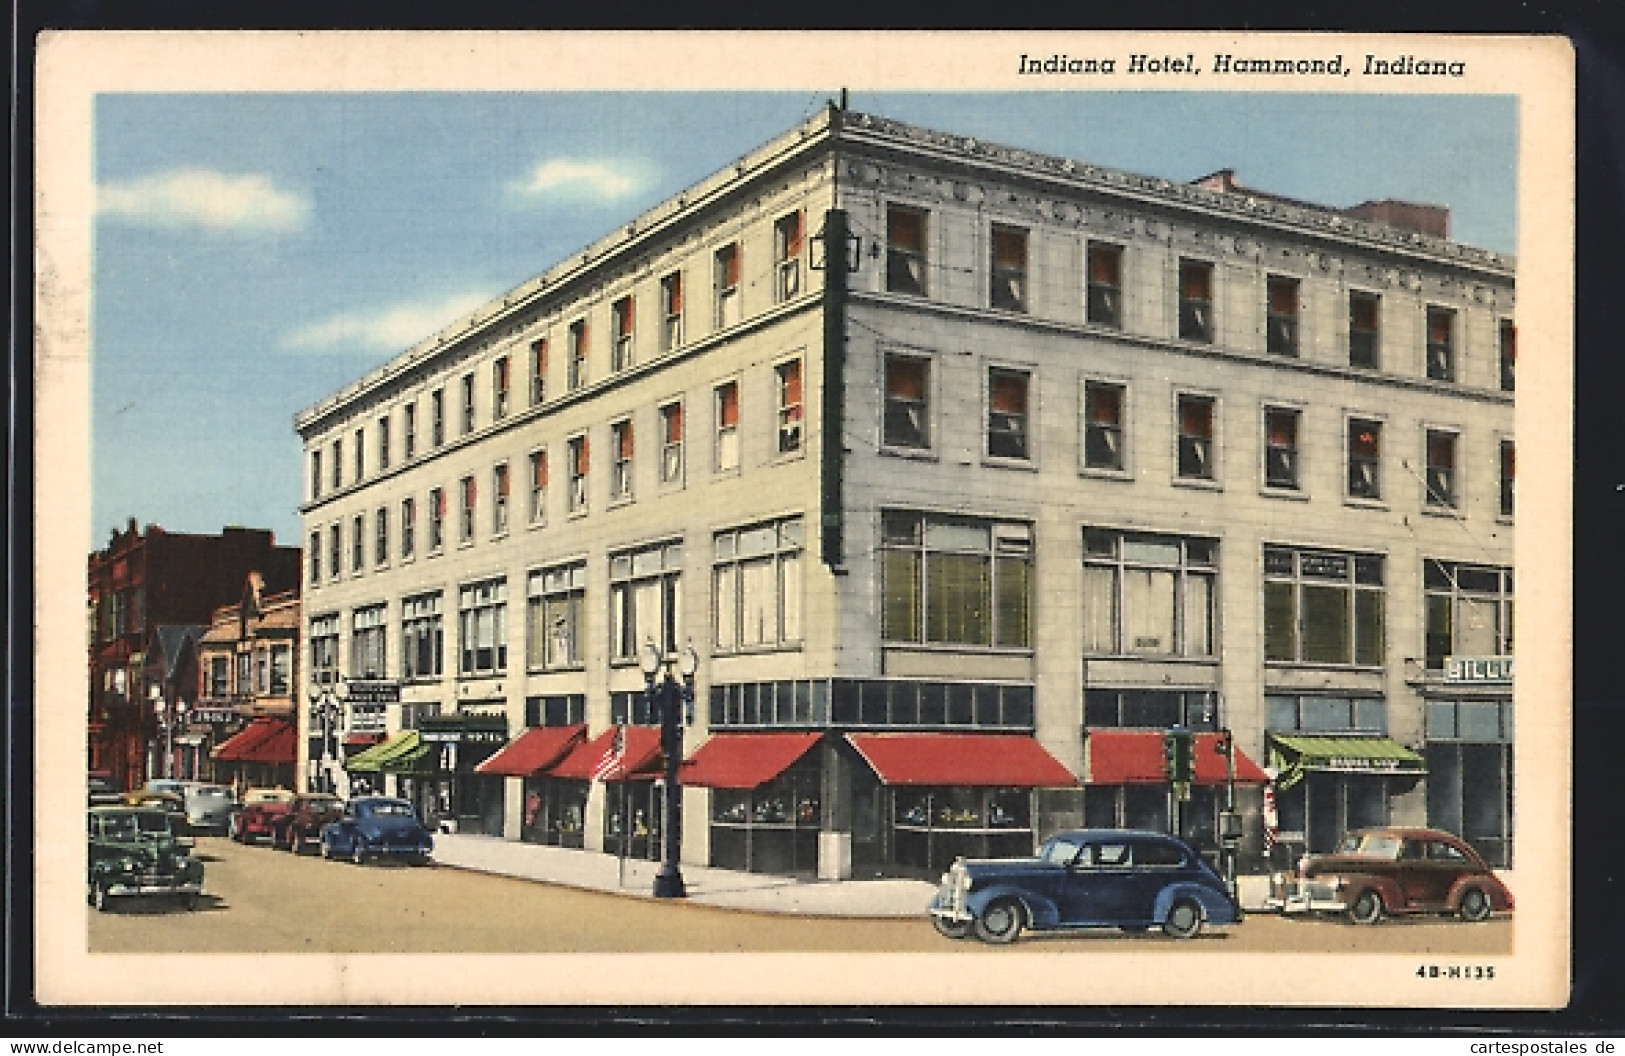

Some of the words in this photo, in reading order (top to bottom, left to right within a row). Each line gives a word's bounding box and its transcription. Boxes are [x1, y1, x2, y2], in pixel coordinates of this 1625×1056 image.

[1018, 54, 1117, 75] Indiana
[1128, 54, 1202, 77] Hotel,
[1213, 54, 1351, 78] Hammond,
[1362, 55, 1466, 76] Indiana
